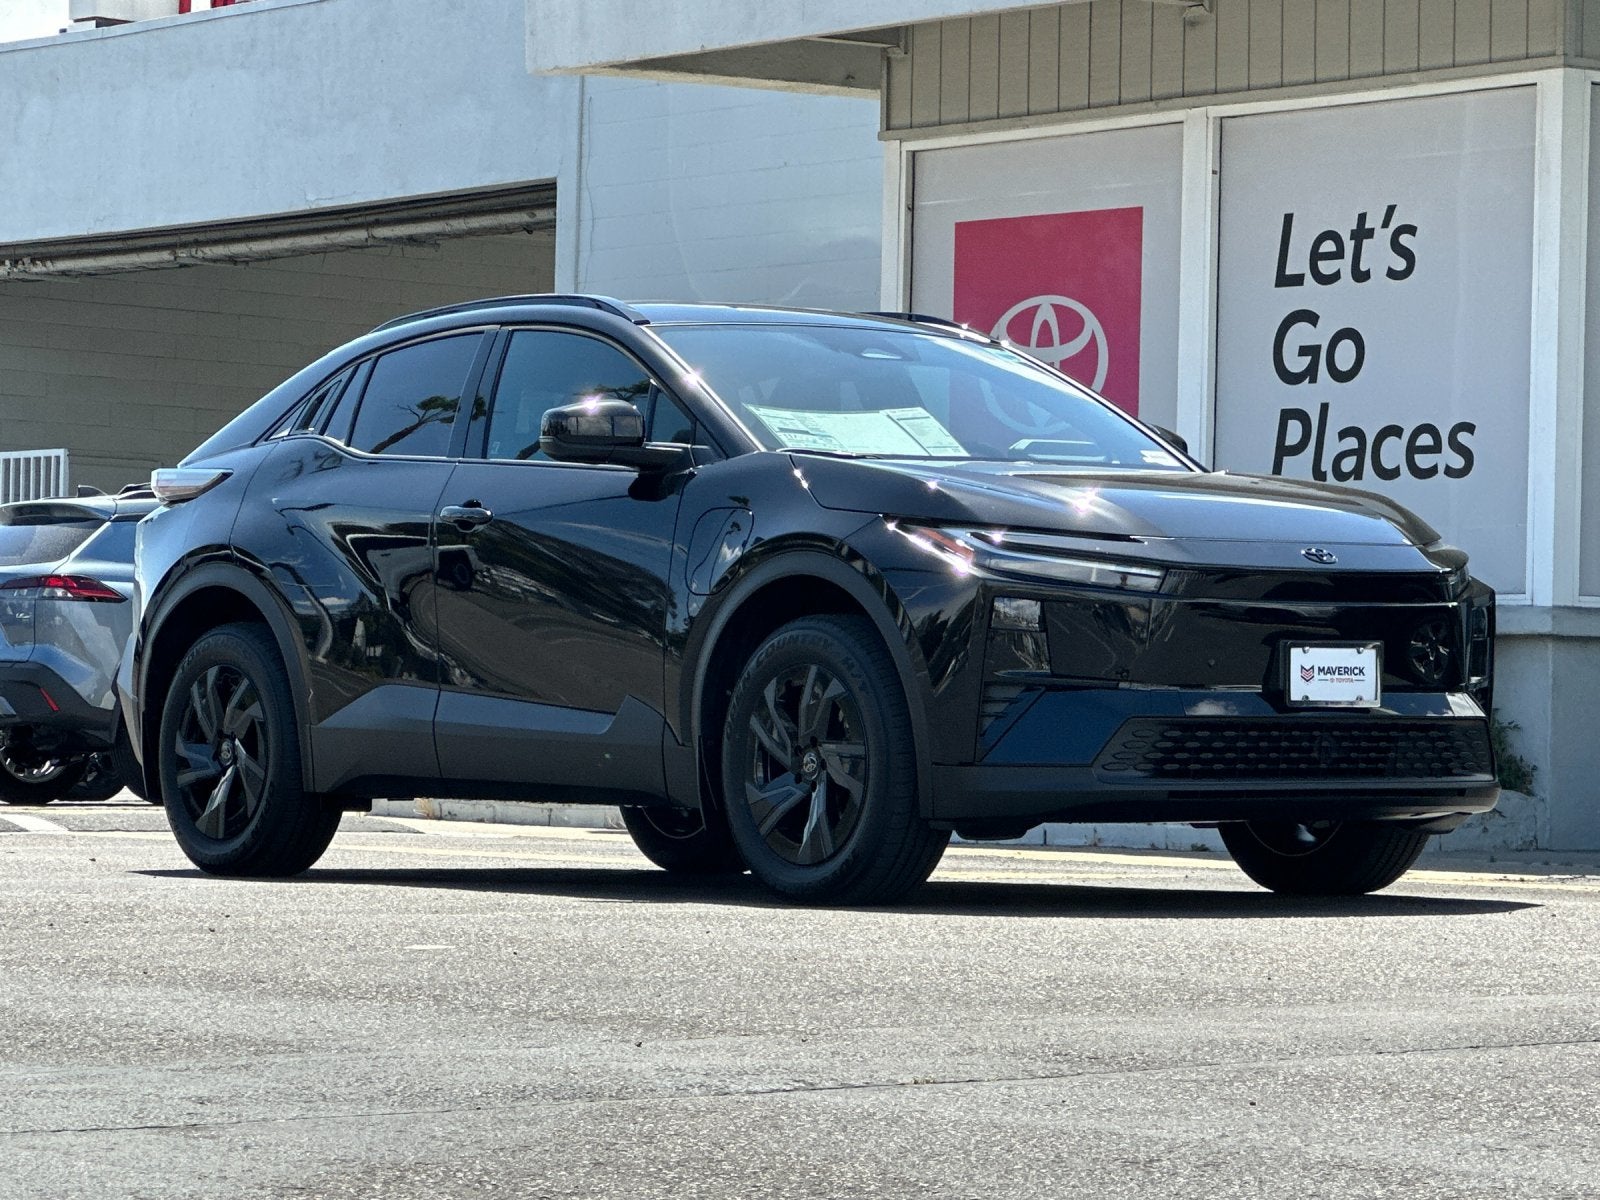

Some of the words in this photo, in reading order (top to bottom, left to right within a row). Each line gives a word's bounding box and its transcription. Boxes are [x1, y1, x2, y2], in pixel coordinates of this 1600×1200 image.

[1274, 204, 1418, 288] Let's
[1272, 309, 1366, 386] Go
[1271, 402, 1477, 482] Places
[1317, 666, 1366, 677] MAVERICK
